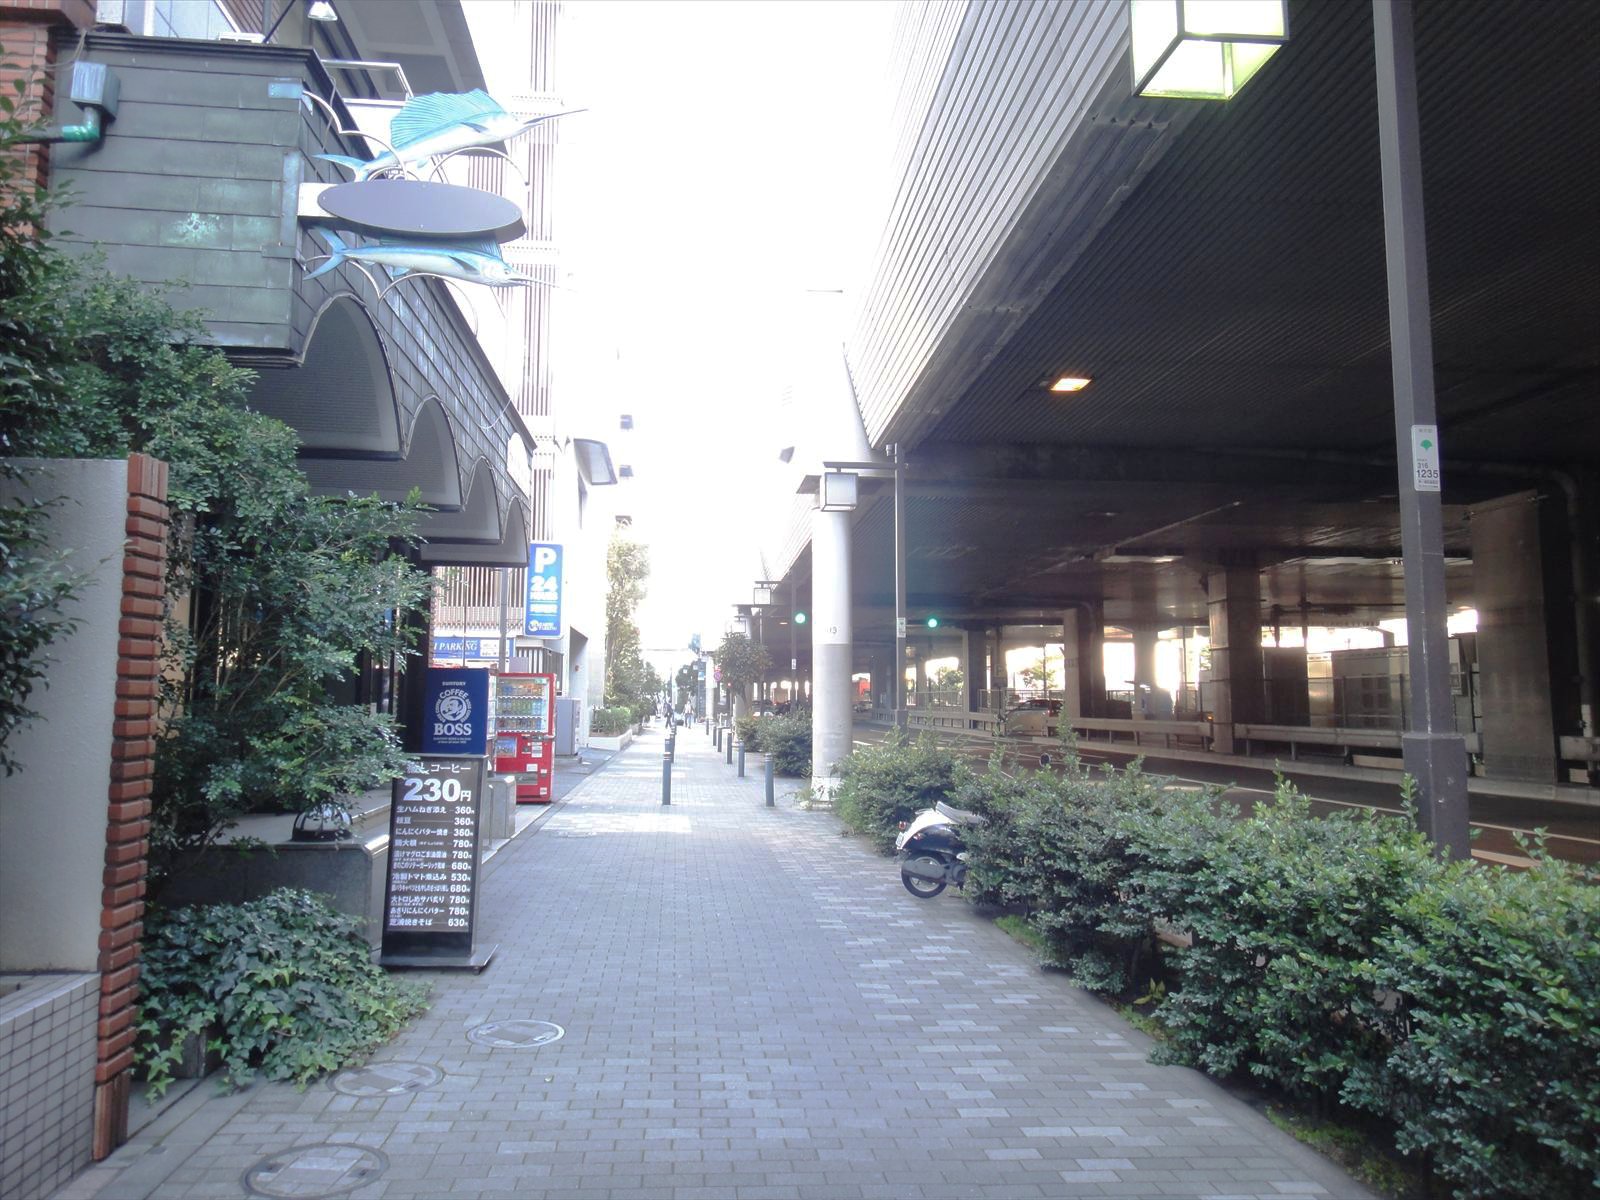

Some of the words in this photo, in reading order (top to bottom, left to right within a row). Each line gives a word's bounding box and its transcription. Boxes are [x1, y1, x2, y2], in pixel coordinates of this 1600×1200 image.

[1416, 469, 1439, 479] 1235
[534, 547, 557, 574] P
[530, 575, 558, 592] 24
[439, 689, 469, 699] COFFEE
[433, 723, 472, 736] BOSS
[403, 778, 472, 802] 230円
